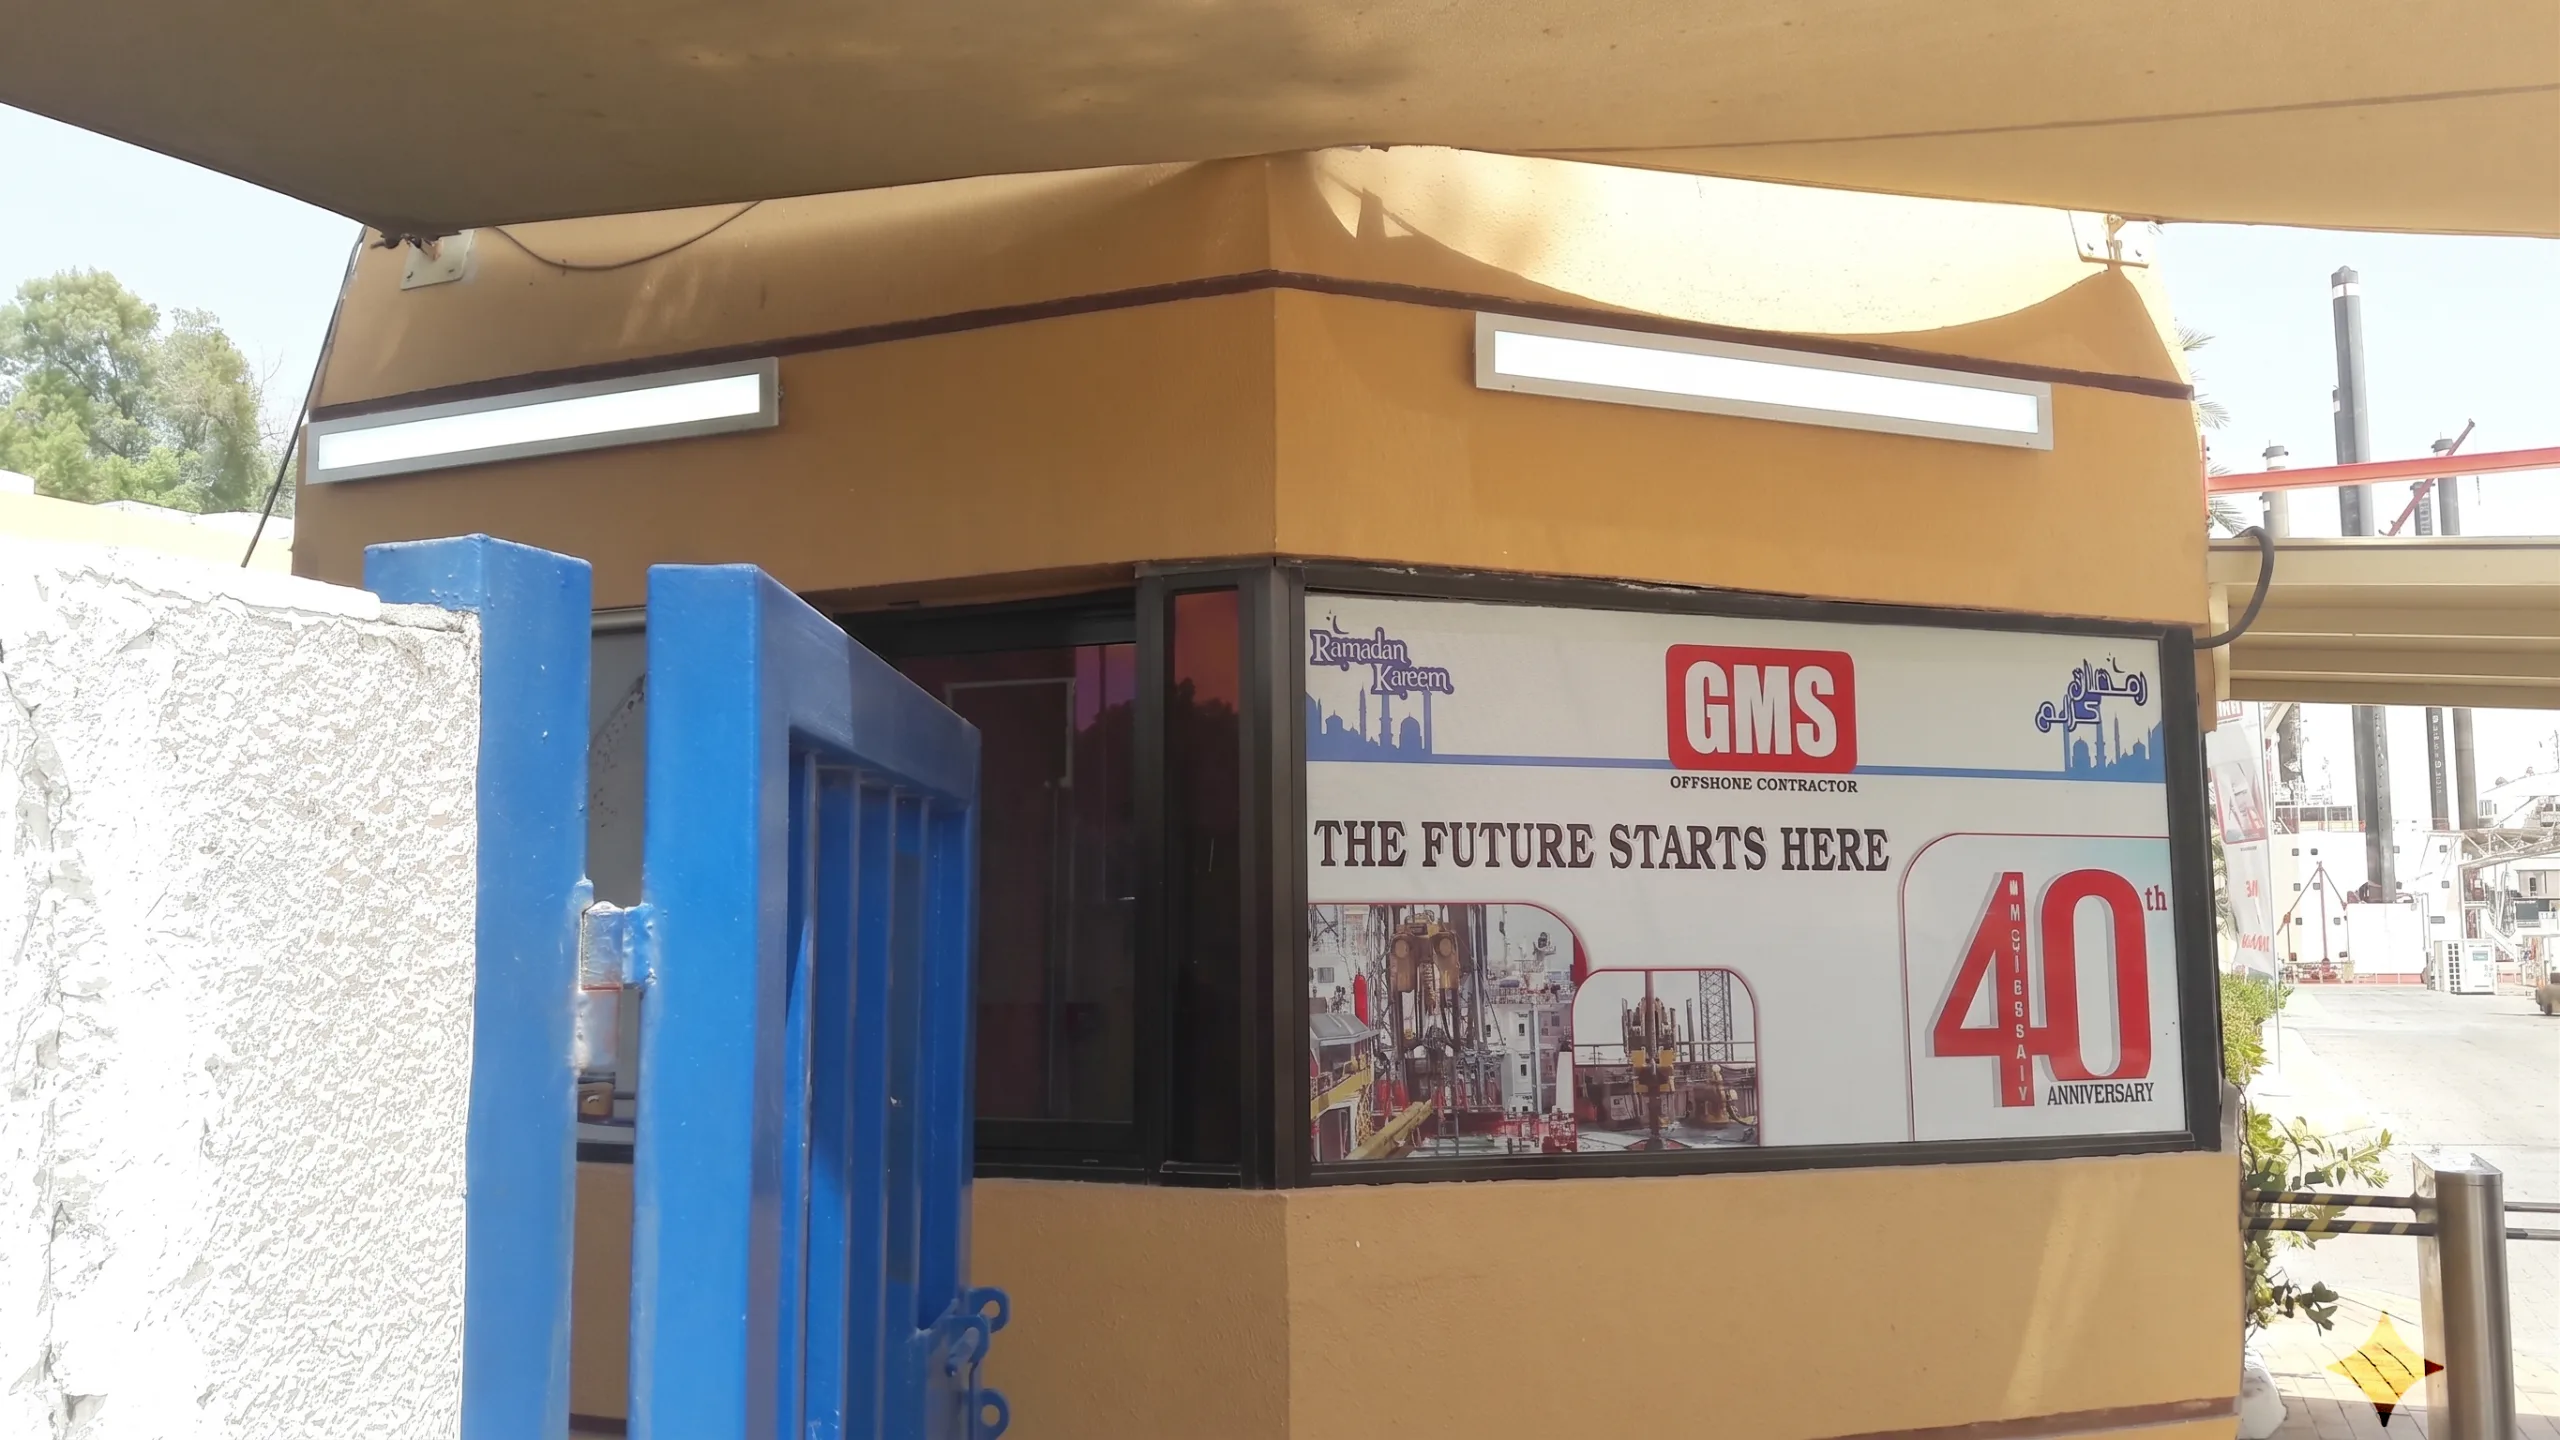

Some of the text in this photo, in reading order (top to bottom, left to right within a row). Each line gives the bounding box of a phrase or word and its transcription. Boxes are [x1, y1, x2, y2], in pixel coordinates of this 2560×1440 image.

[1311, 628, 1409, 666] Ramadan
[1372, 661, 1452, 694] Kareem
[1685, 661, 1837, 758] GMS
[1757, 777, 1859, 793] CONTRACTOR
[1314, 819, 1890, 872] THE FUTURE STARTS HERE
[2047, 1081, 2155, 1106] ANNIVERSARY
